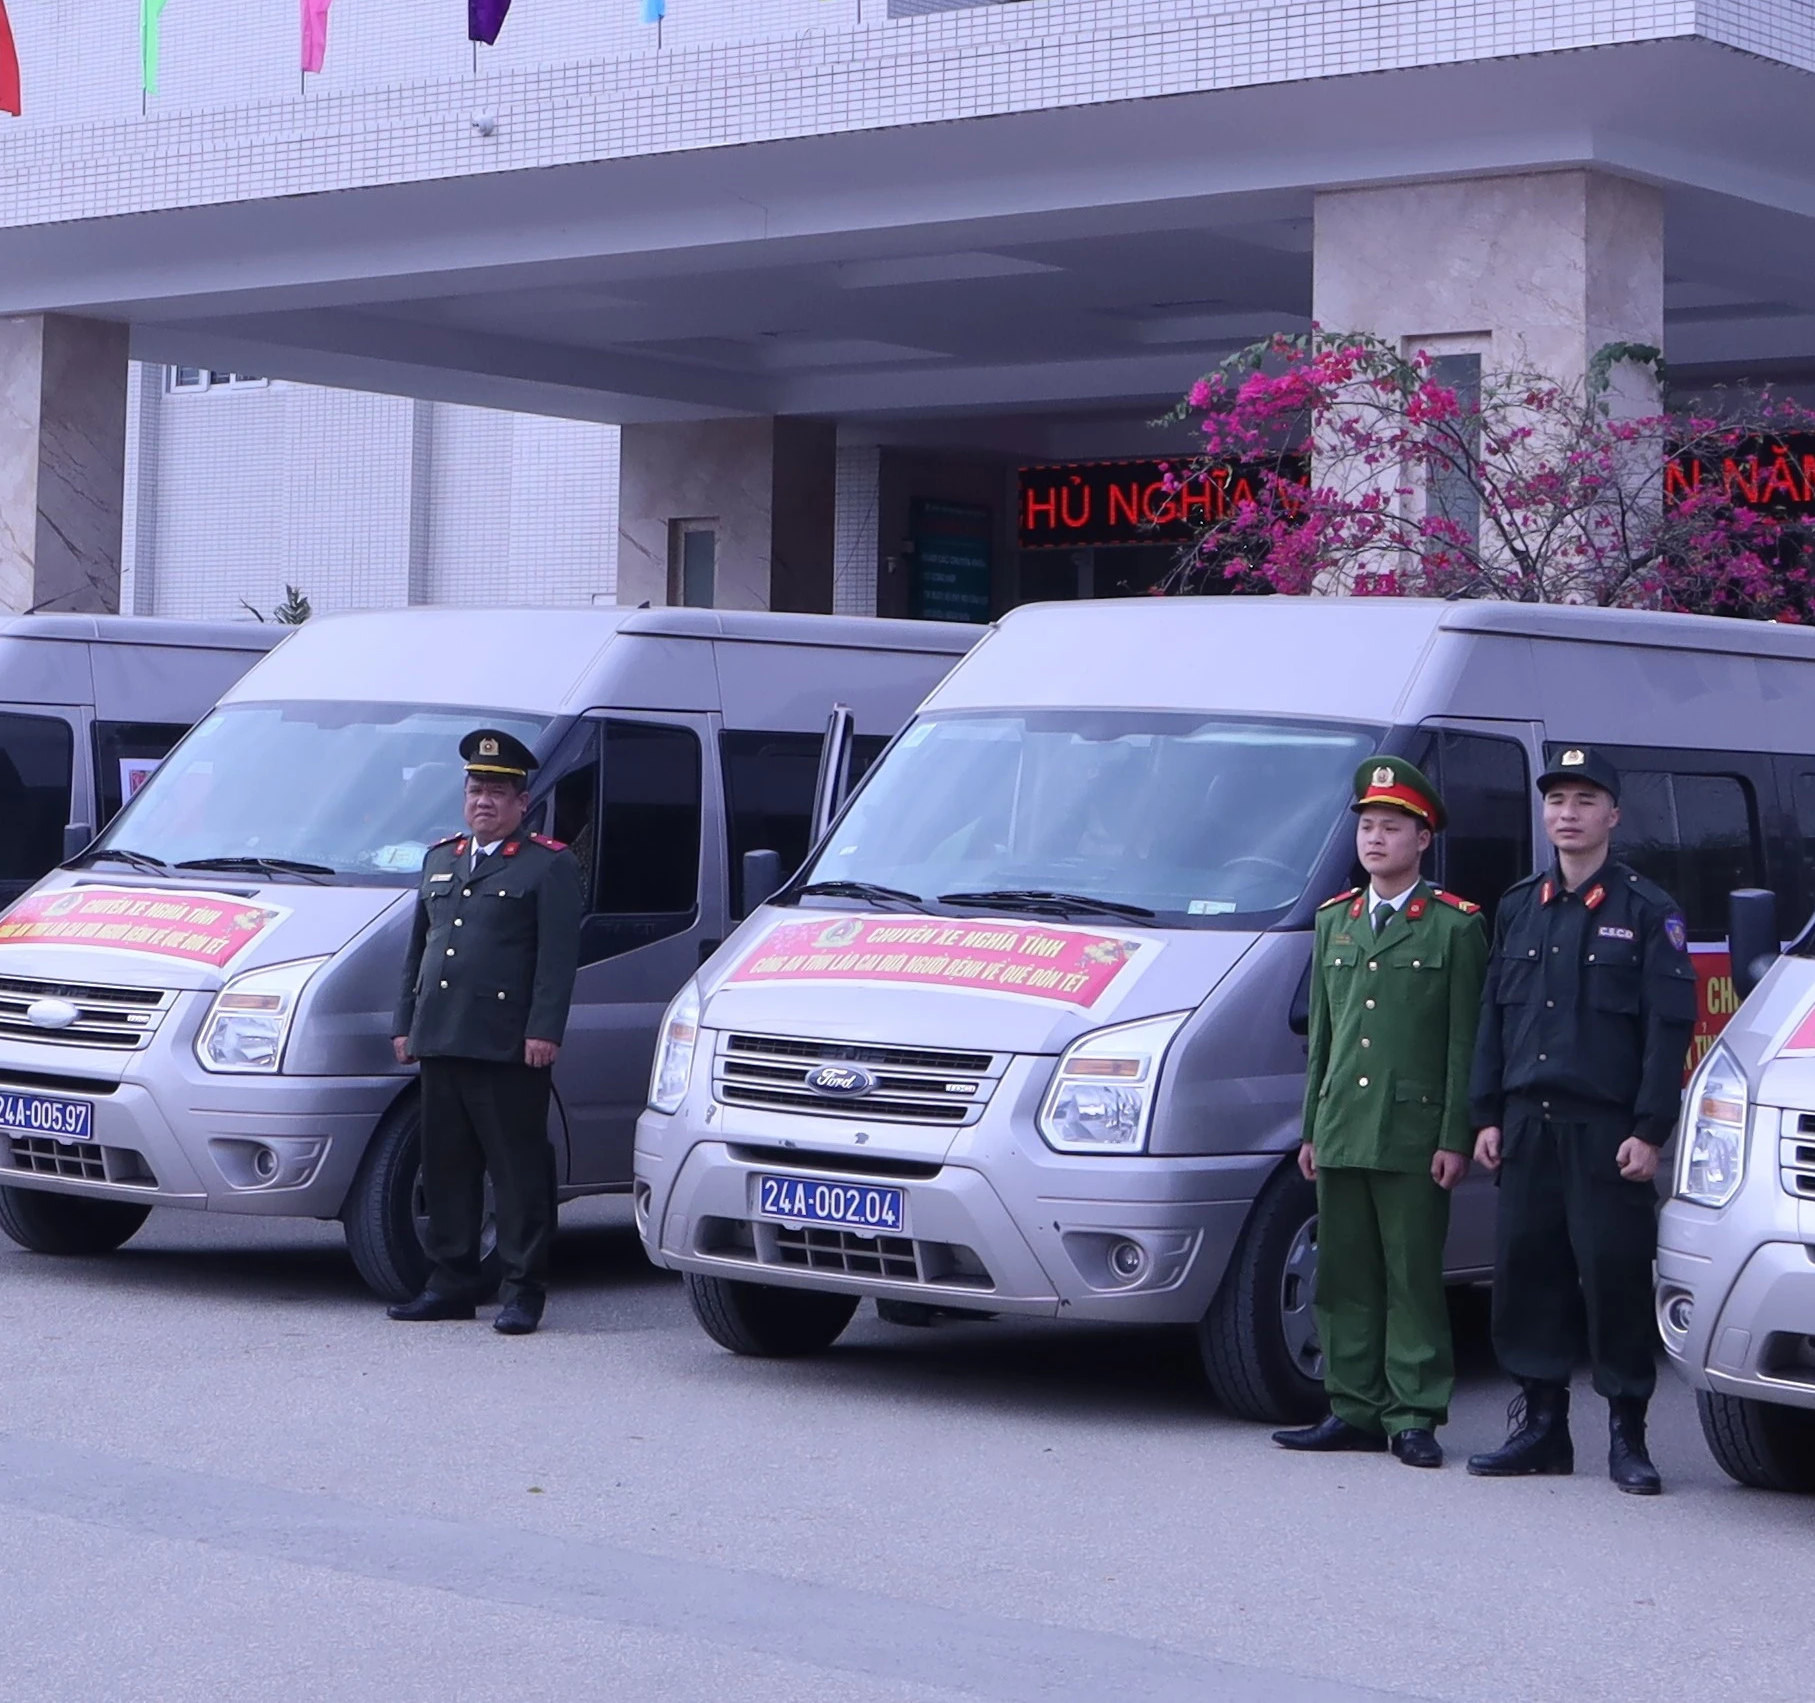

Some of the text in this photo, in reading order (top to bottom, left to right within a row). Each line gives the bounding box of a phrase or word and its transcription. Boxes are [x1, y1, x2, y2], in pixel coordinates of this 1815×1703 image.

[1107, 469, 1256, 526] NGHĨA
[866, 924, 1068, 959] CHUYẾN XE NGHĨA TÌNH
[853, 953, 881, 972] CAI
[1057, 969, 1090, 993] TẾT
[816, 1068, 857, 1090] Ford
[764, 1179, 896, 1226] 24A-002.04
